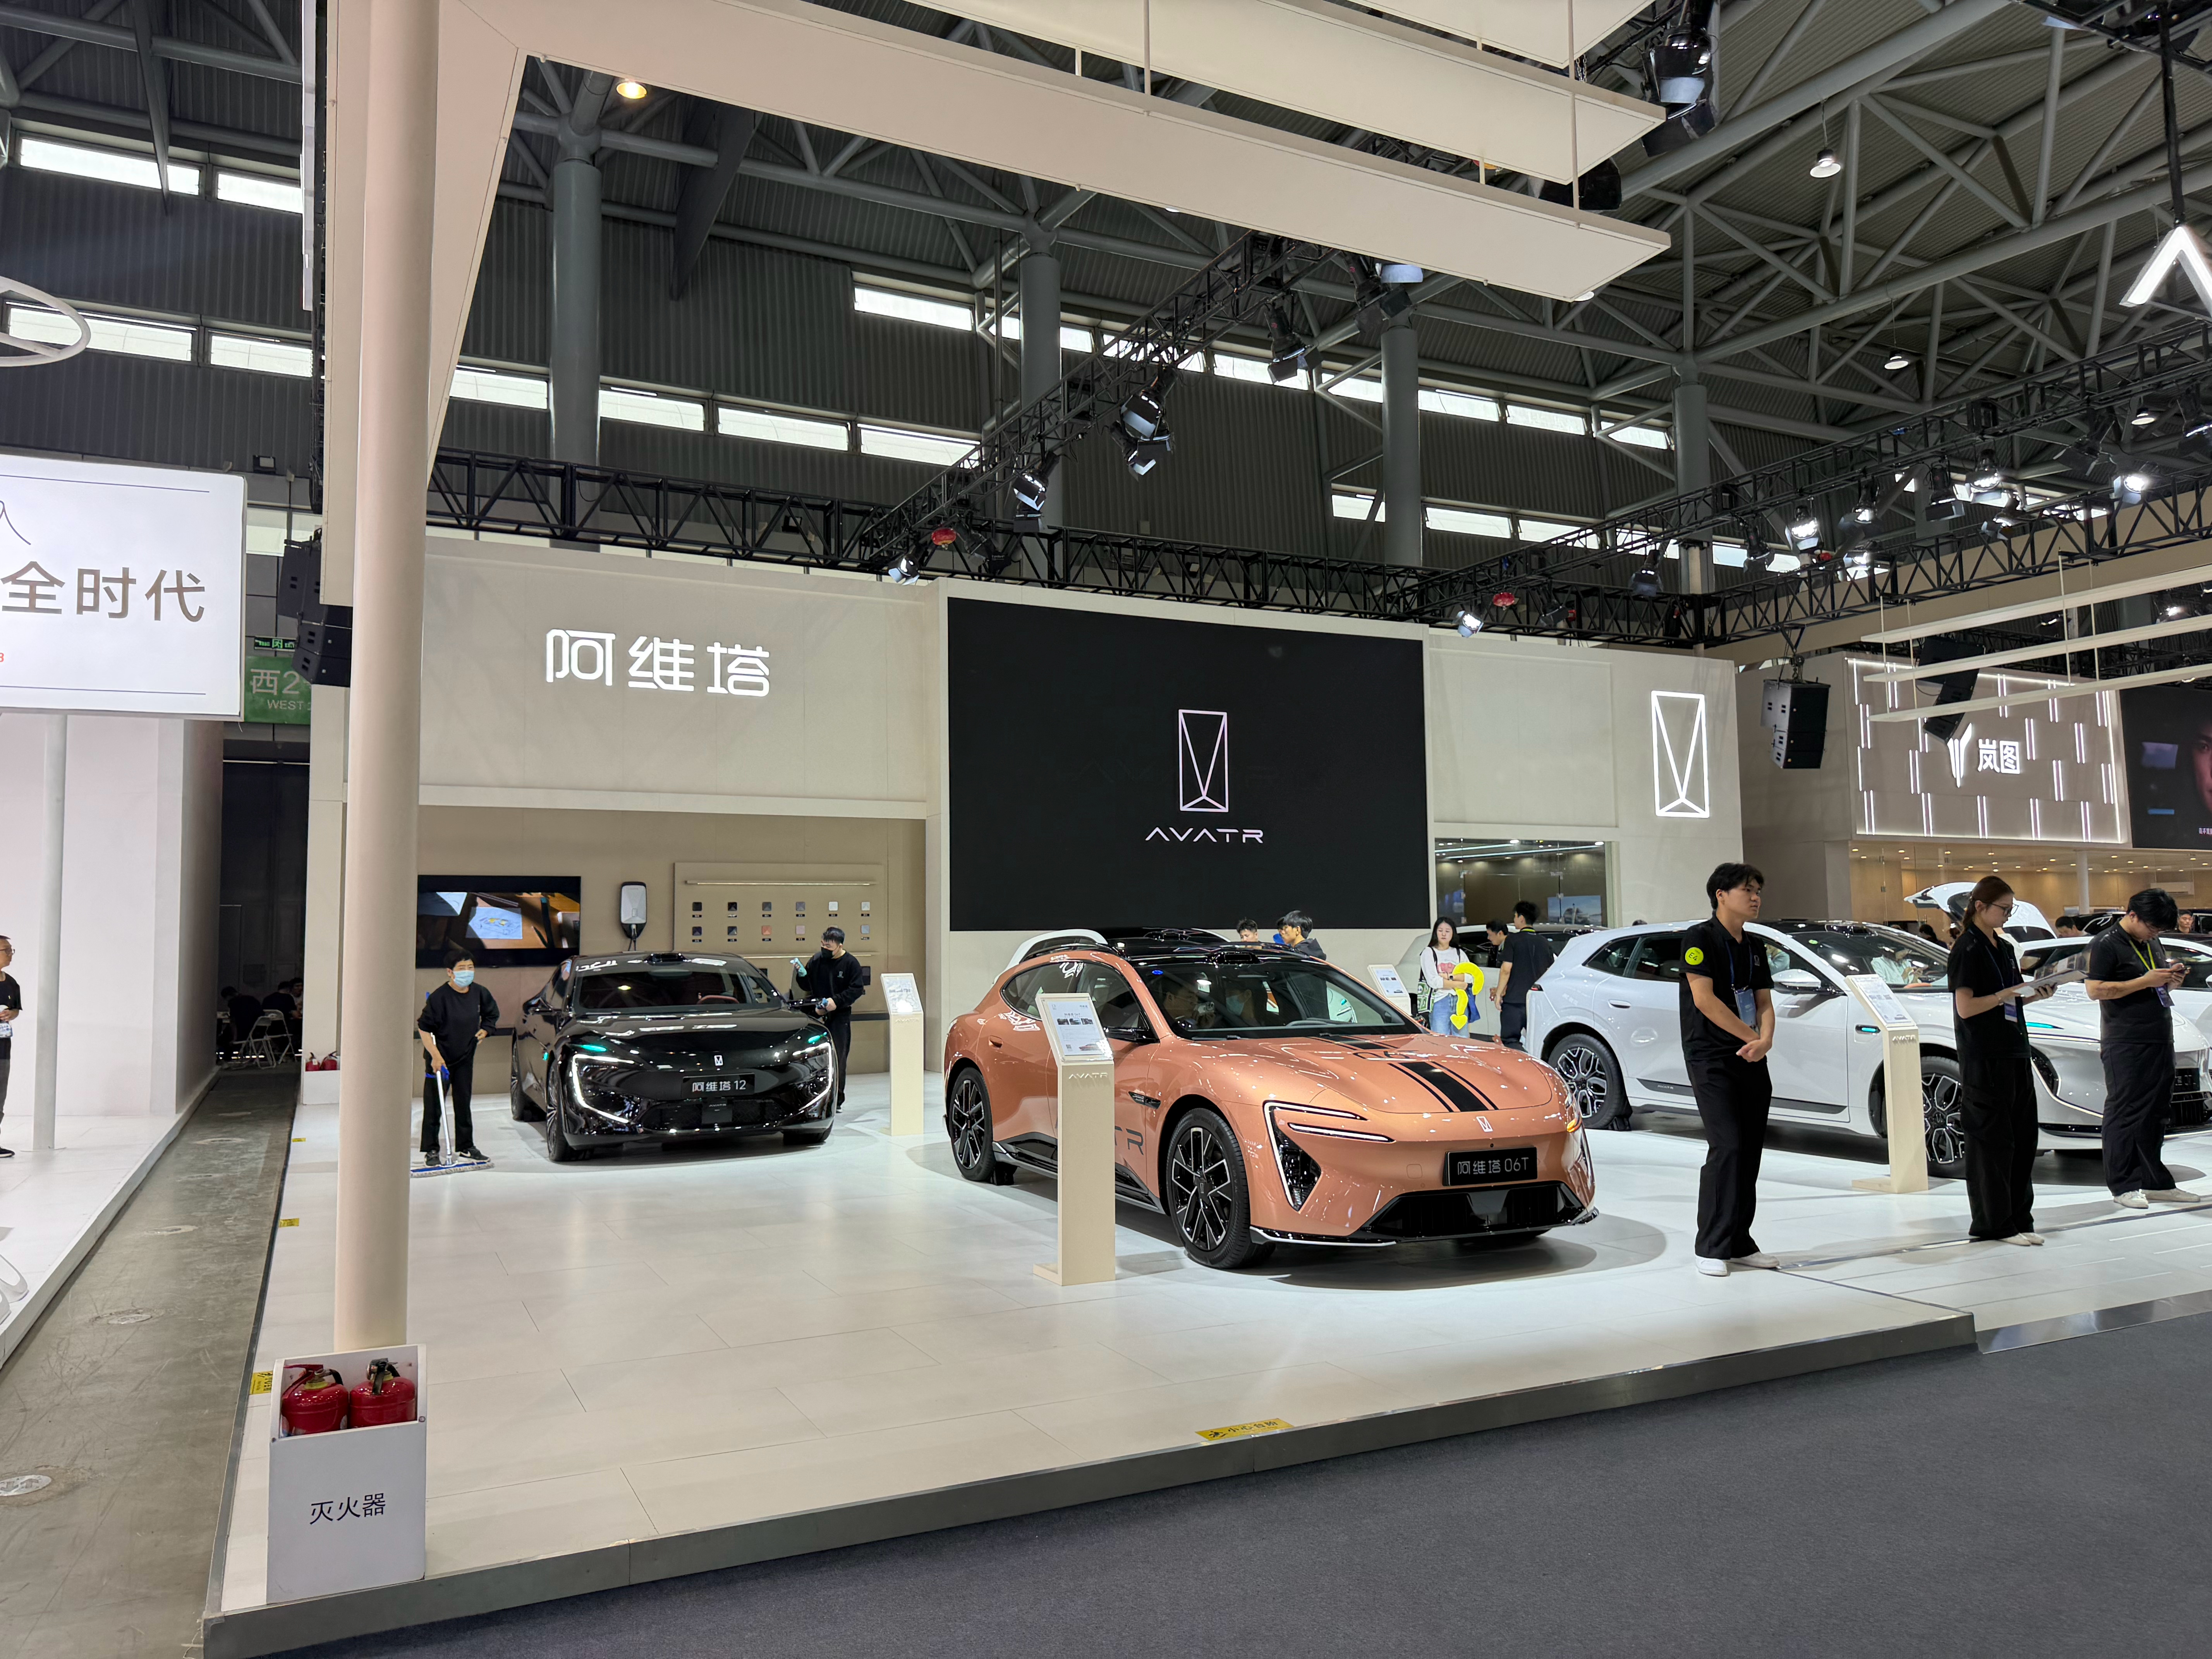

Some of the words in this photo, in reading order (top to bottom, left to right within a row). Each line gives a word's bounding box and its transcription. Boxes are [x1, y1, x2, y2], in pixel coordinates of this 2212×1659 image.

[0, 561, 205, 622] 全时代
[546, 629, 770, 697] 阿维塔
[267, 700, 304, 710] WEST
[1977, 738, 2020, 774] 岚图
[1145, 827, 1263, 843] AVATR
[309, 1493, 386, 1525] 灭火器
